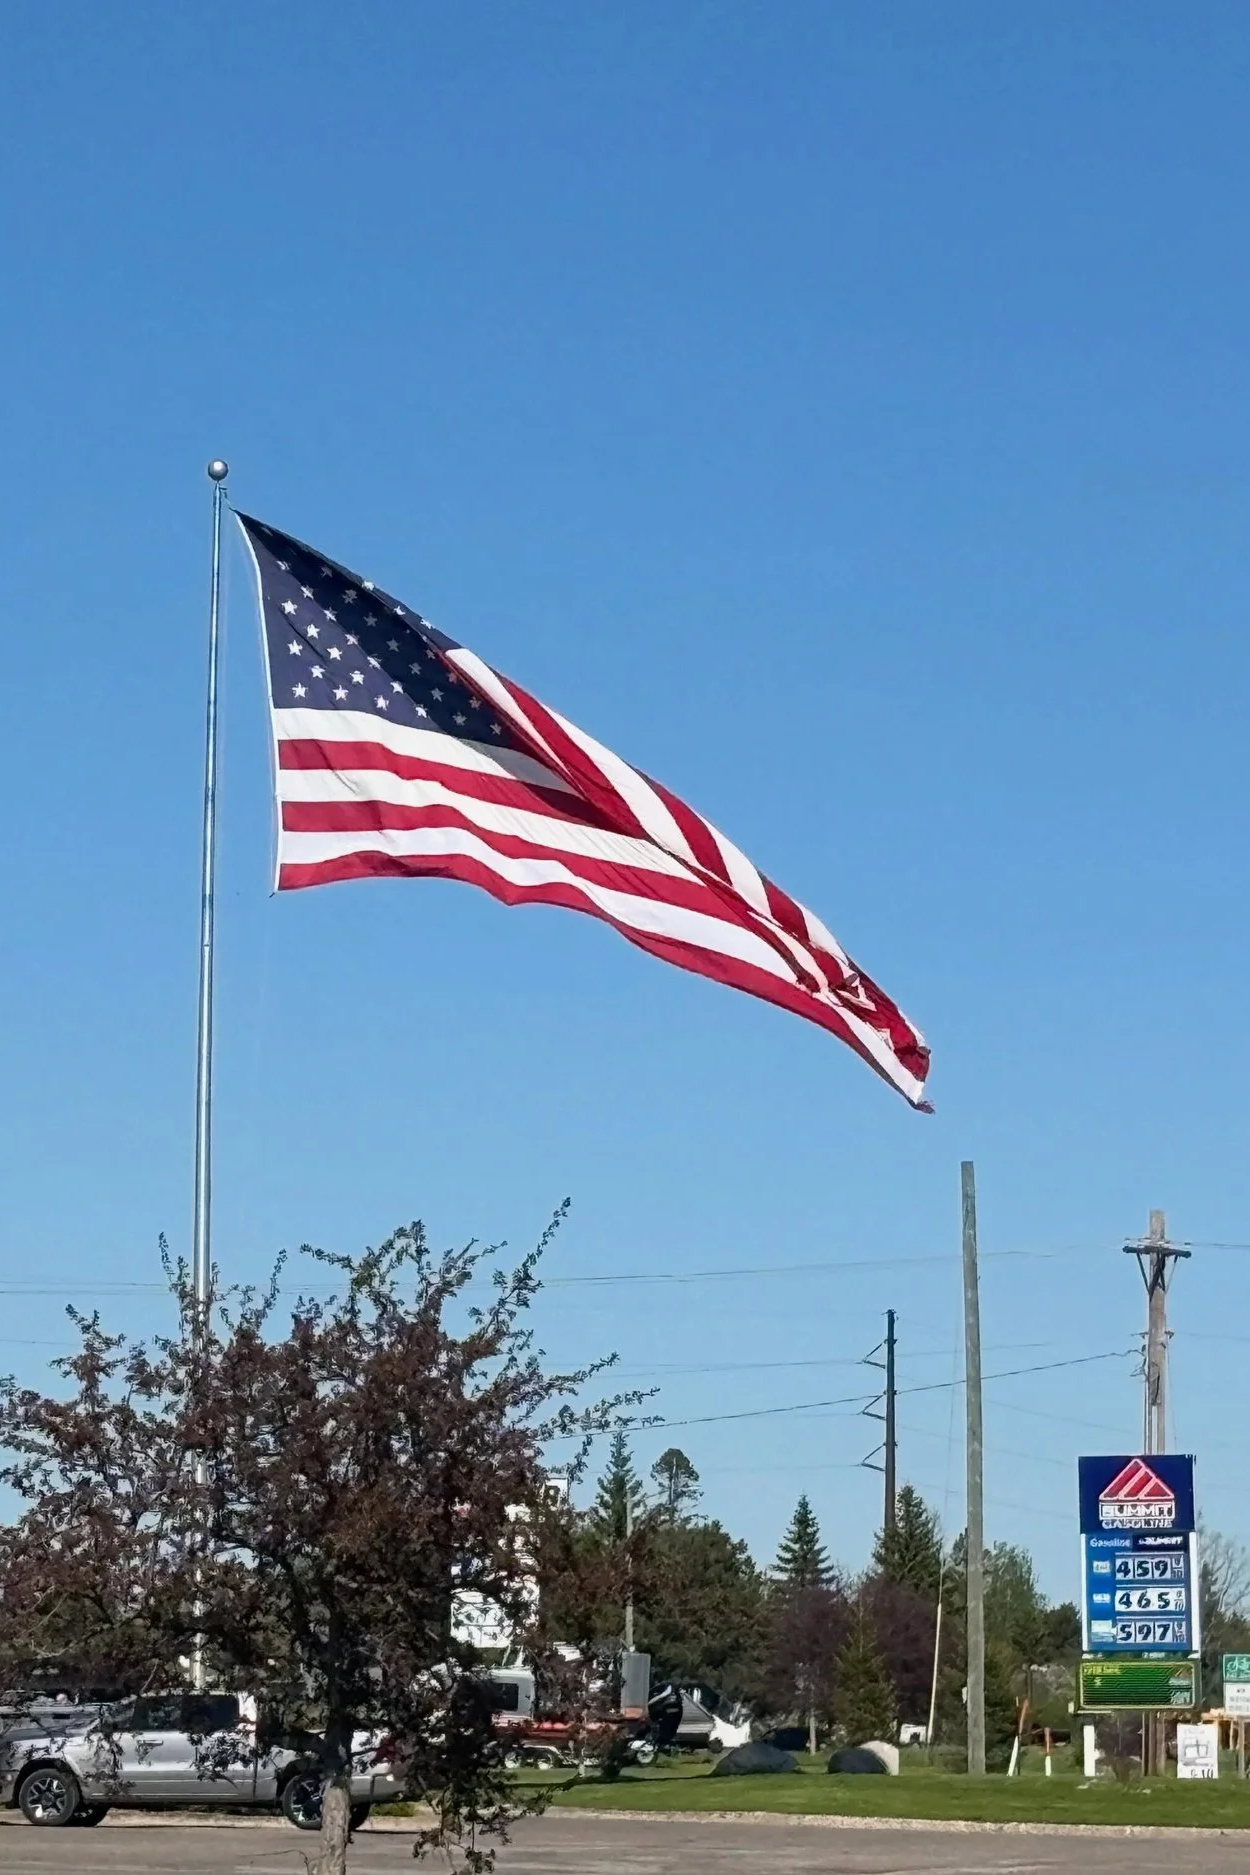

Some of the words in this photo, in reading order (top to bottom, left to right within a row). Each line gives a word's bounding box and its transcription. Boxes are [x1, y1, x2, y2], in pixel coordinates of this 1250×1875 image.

[1101, 1504, 1173, 1517] SUMMIT
[1116, 1560, 1168, 1578] 459
[1118, 1591, 1170, 1609] 465
[1117, 1623, 1171, 1642] 597
